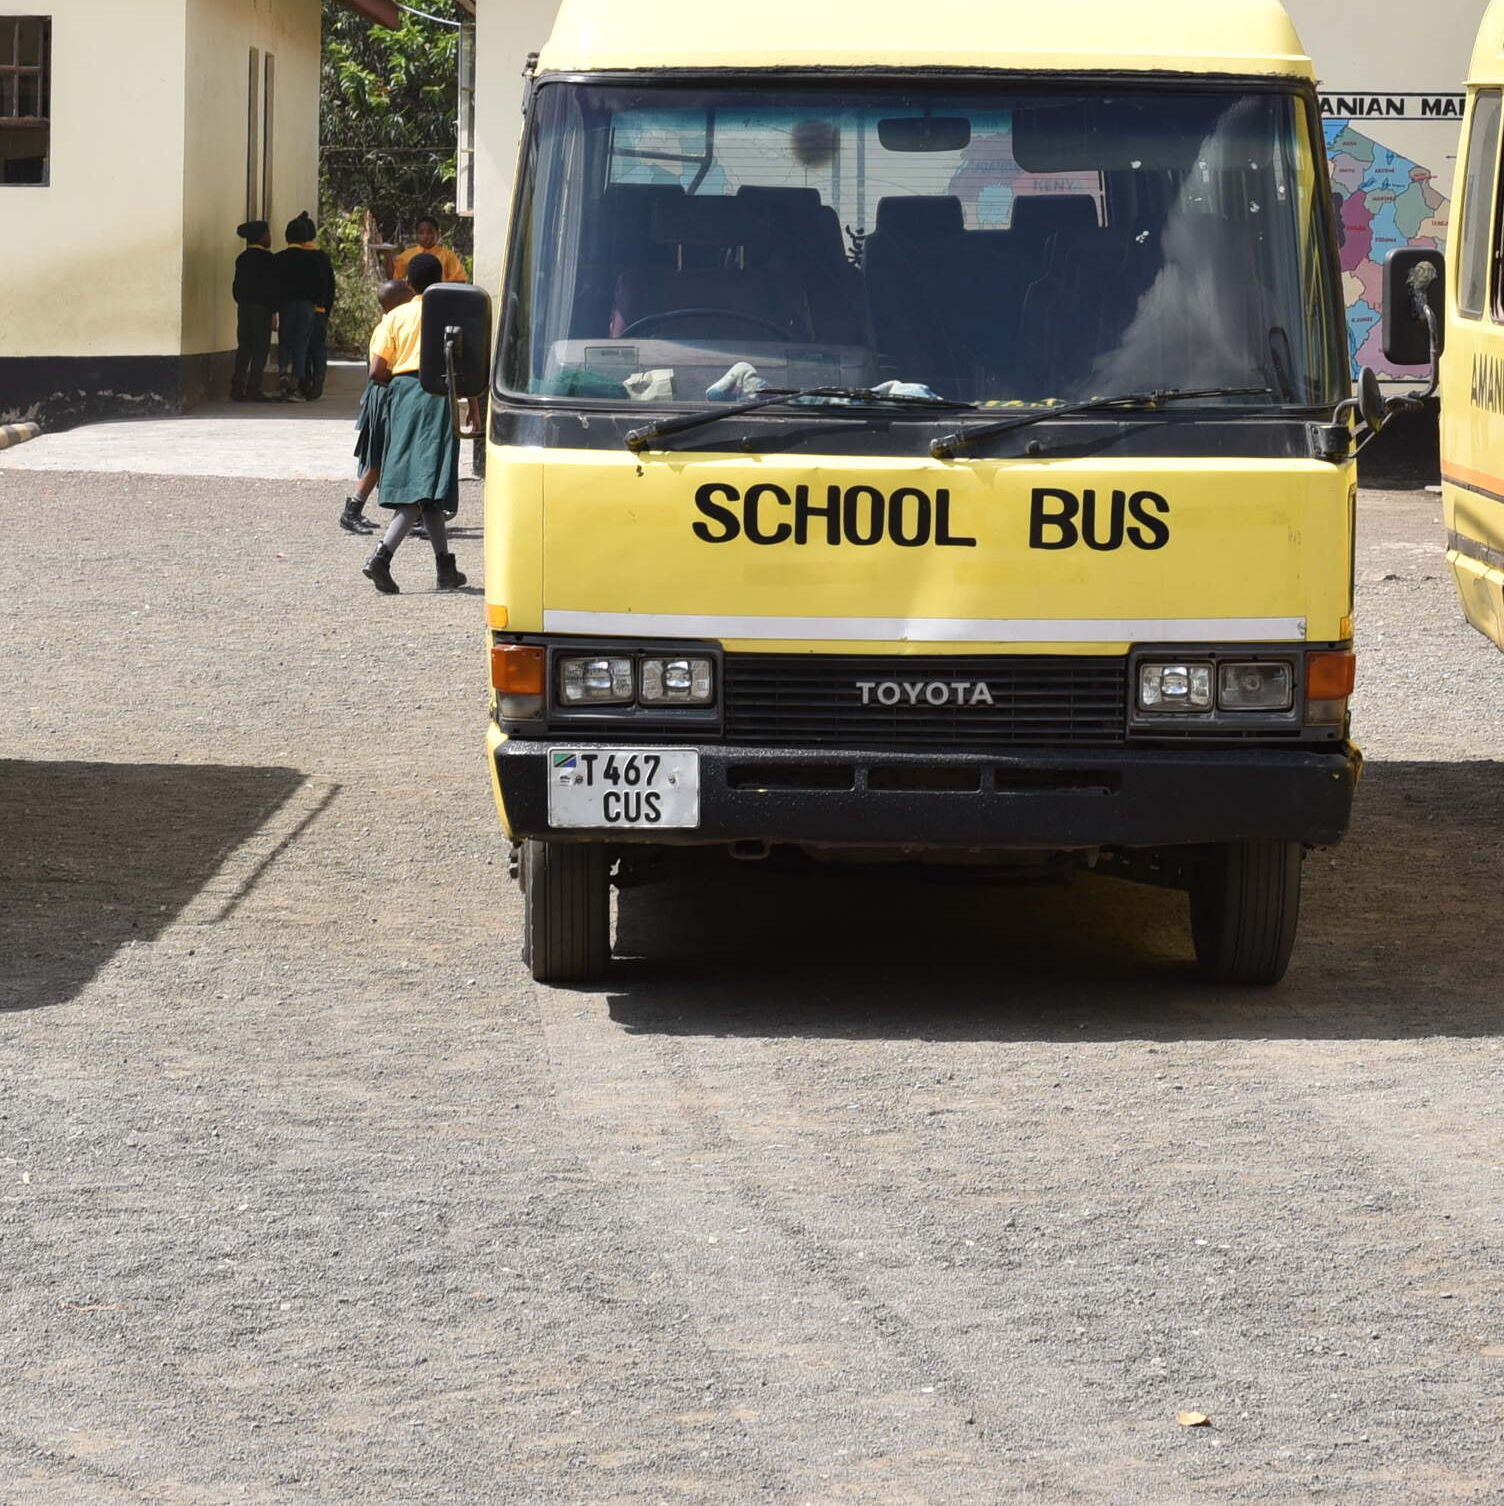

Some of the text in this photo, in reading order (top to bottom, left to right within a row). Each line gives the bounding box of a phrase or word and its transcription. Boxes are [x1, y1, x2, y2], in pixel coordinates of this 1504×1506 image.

[691, 482, 1170, 551] SCHOOL BUS
[856, 681, 994, 705] TOYOTA
[603, 791, 661, 823] CUS
